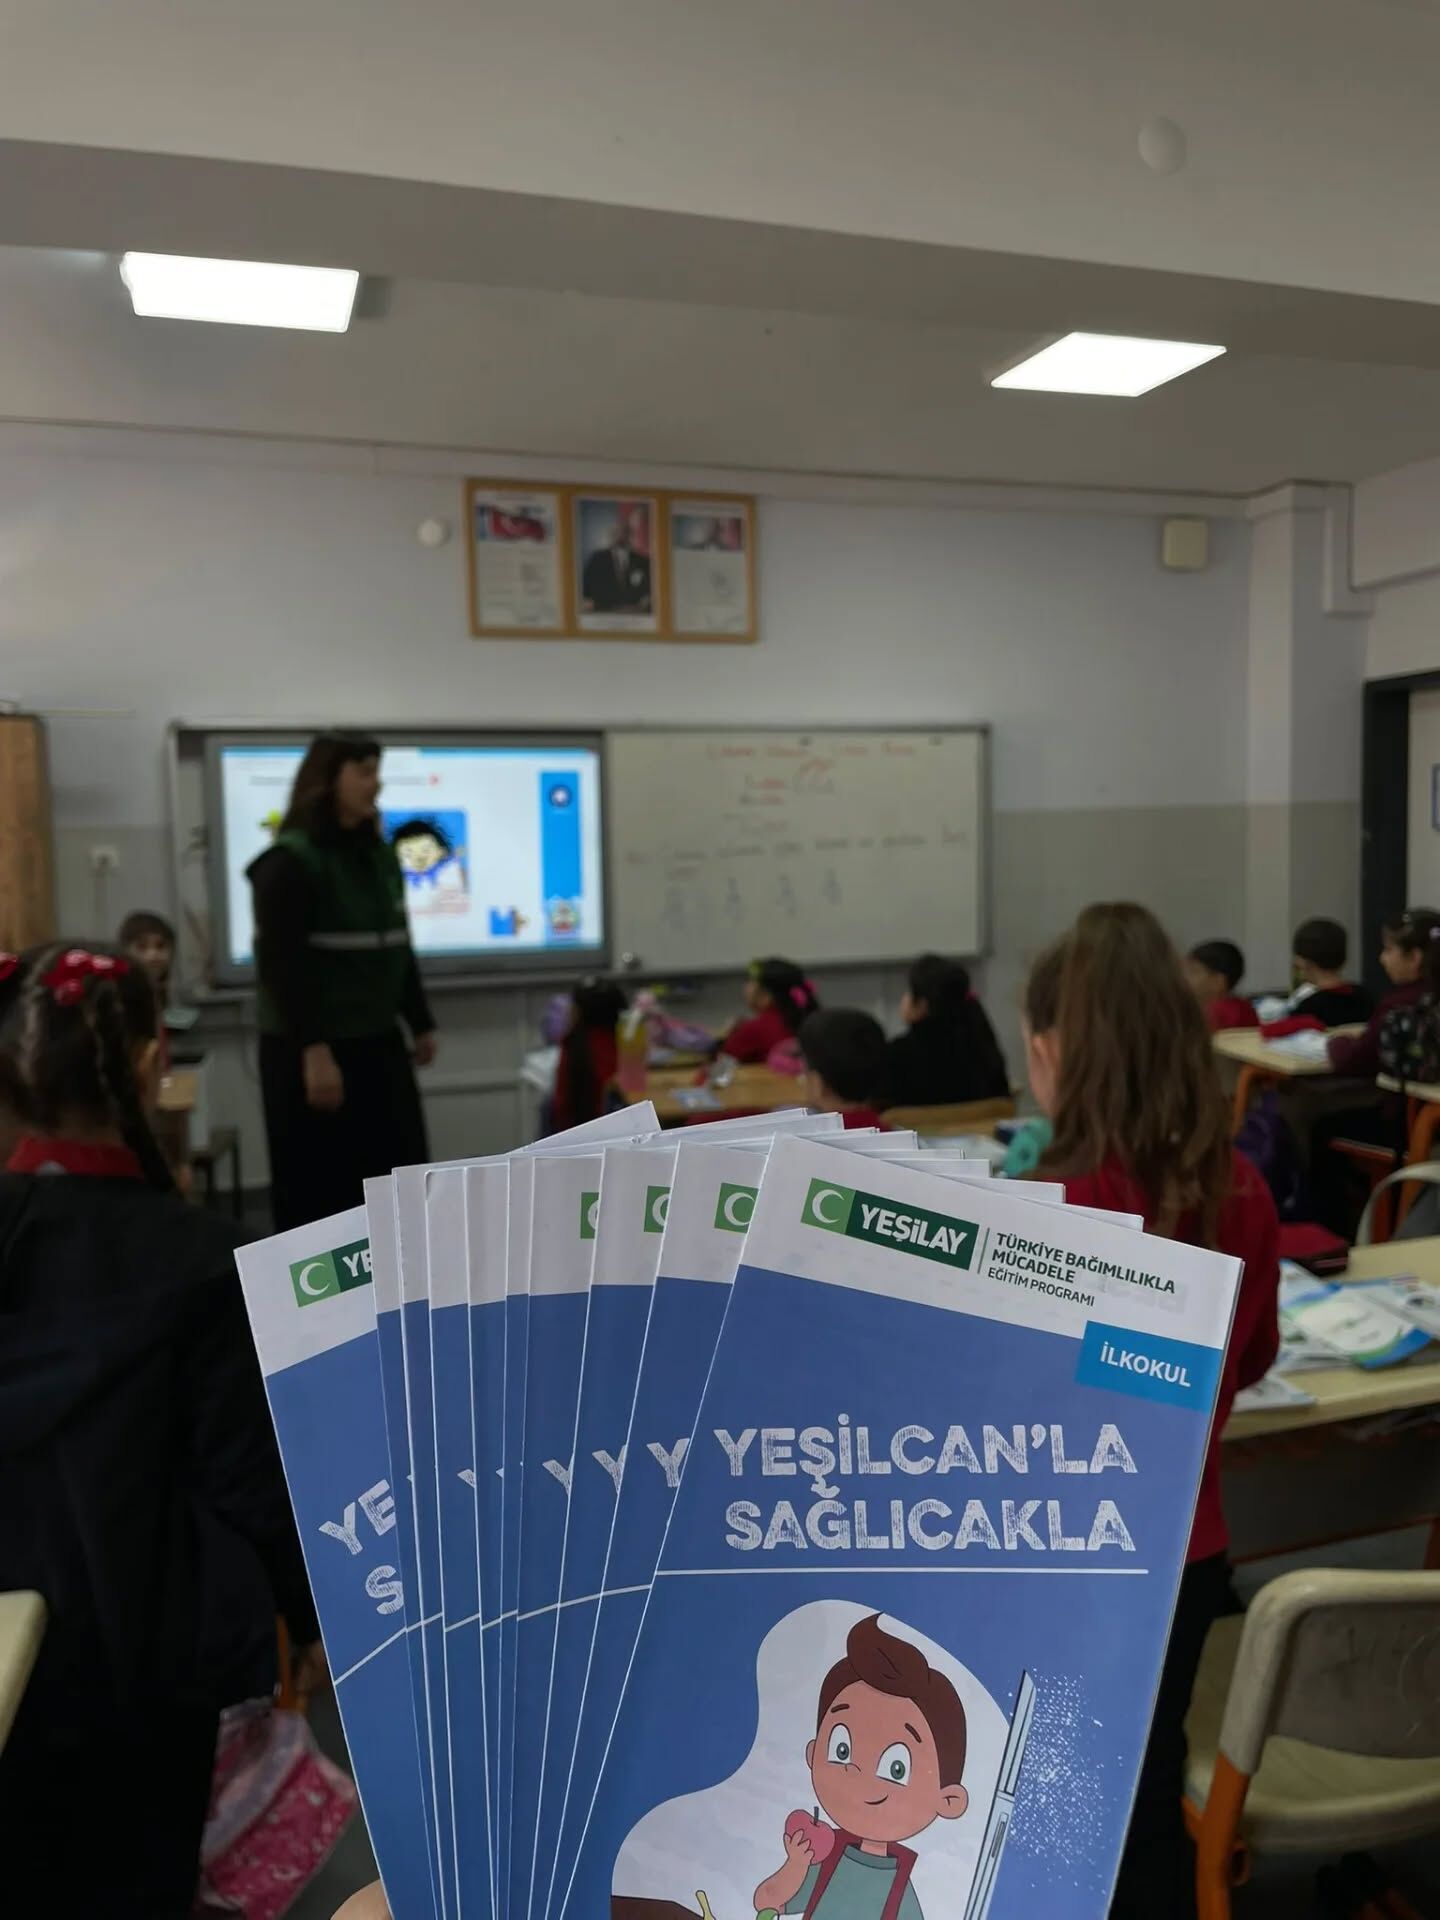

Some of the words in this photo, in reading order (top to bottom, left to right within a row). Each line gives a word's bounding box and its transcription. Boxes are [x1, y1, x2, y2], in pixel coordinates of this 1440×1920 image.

[988, 1266, 1028, 1288] EĞİTİM
[1030, 1278, 1095, 1307] PROGRAMI
[991, 1248, 1075, 1283] MÜCADELE
[997, 1233, 1065, 1265] TÜRKİYE
[1066, 1252, 1176, 1294] BAĞIMLILIKLA
[1100, 1341, 1191, 1387] İLKOKUL
[725, 1487, 1137, 1551] SAĞLICAKLA
